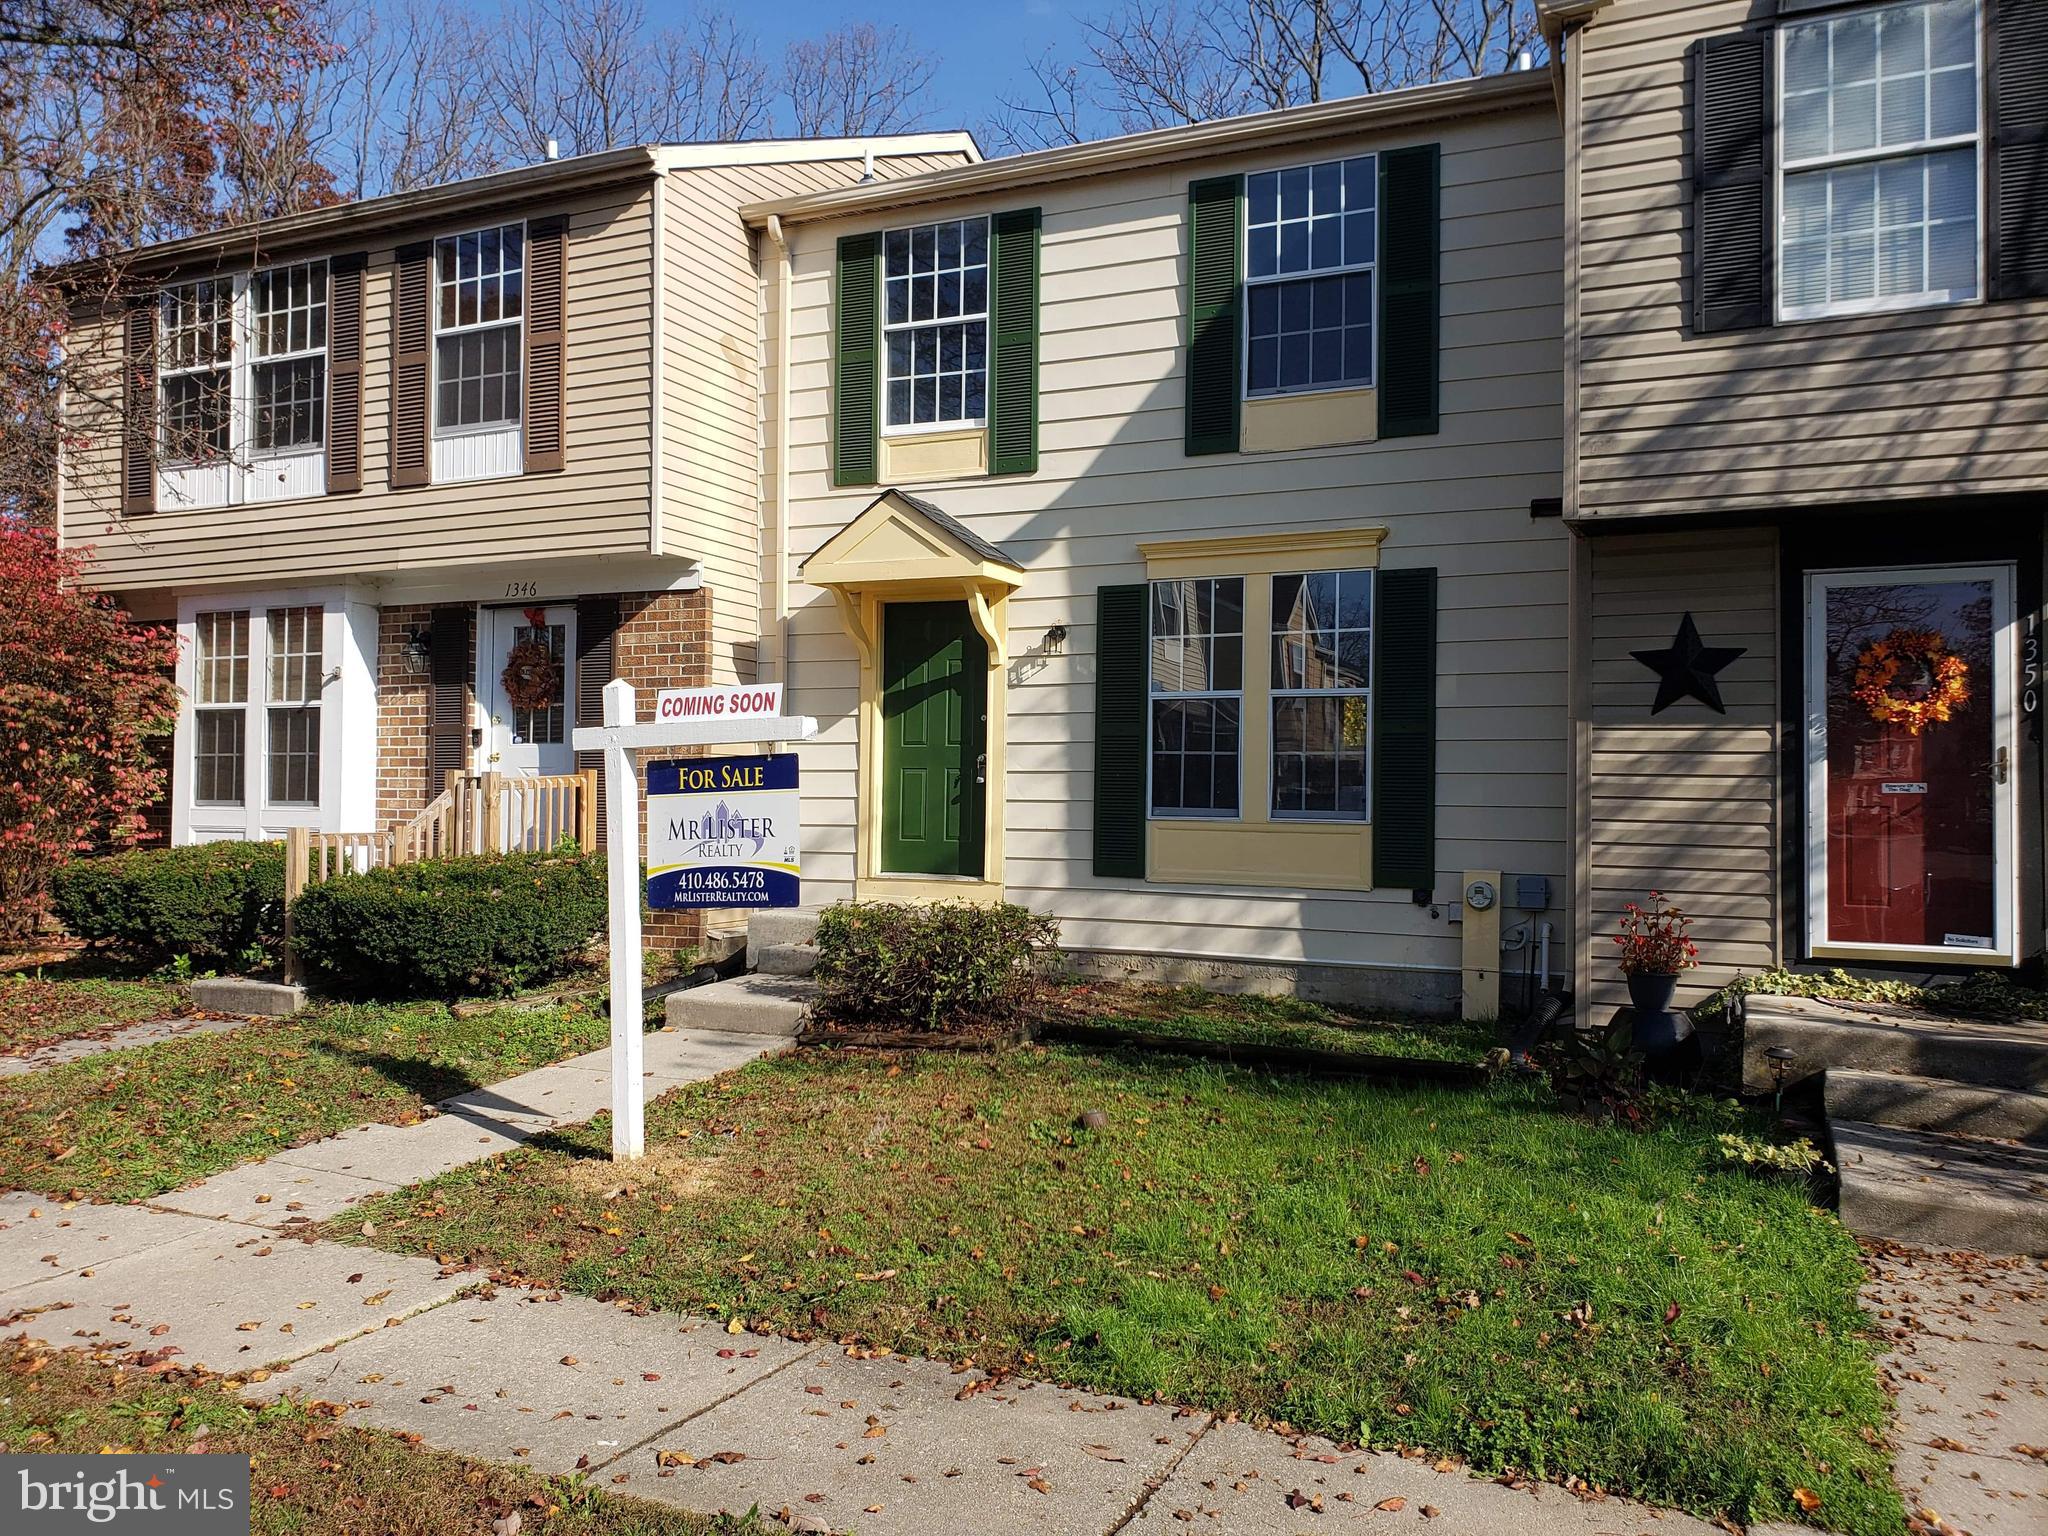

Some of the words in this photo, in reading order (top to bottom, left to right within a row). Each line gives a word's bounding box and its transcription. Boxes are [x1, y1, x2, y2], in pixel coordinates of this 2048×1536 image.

[504, 581, 537, 598] 1346
[2023, 613, 2038, 712] 1350
[661, 694, 725, 717] COMING
[729, 691, 776, 714] SOON
[678, 767, 717, 790] FOR
[721, 765, 764, 788] SALE
[698, 843, 743, 858] REALTY
[678, 871, 765, 889] 410.486.5478
